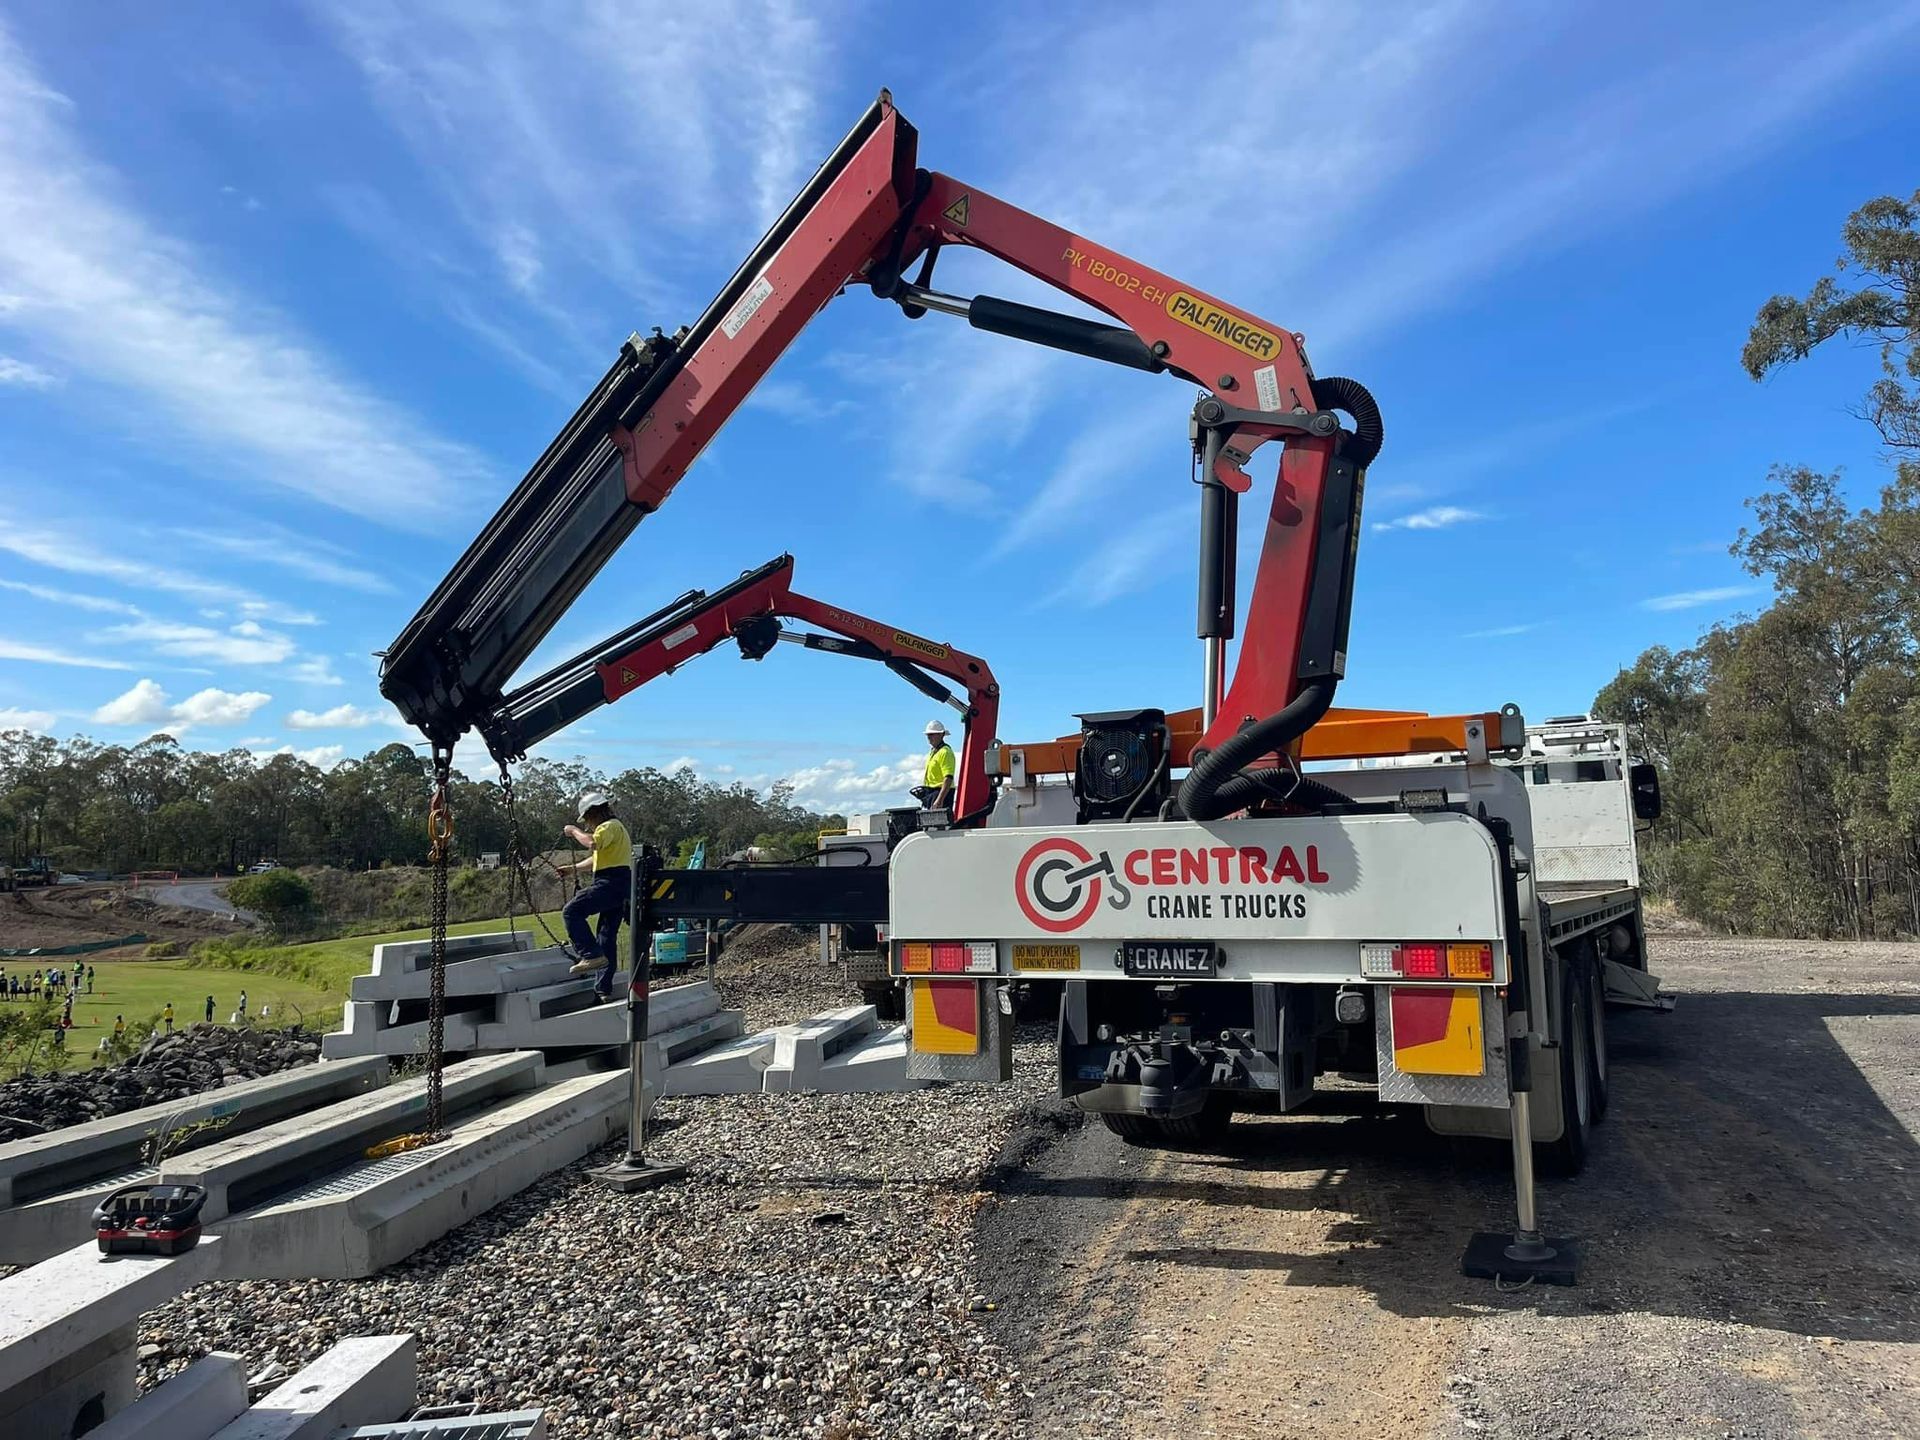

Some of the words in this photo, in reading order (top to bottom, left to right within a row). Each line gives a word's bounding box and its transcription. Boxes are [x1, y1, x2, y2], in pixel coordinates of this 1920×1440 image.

[1062, 248, 1086, 268] PK
[1171, 296, 1274, 357] PALFINGER
[895, 633, 945, 657] PALFINGER
[1124, 845, 1329, 885] CENTRAL
[1148, 895, 1212, 919] CRANE
[1221, 894, 1306, 919] TRUCKS
[1015, 945, 1025, 957] DO
[1026, 945, 1040, 957] NOT
[1041, 945, 1076, 957] OVERTAKE
[1016, 957, 1047, 968] TURNING
[1048, 957, 1076, 969] VEHICLE
[1135, 948, 1209, 970] CRANEZ
